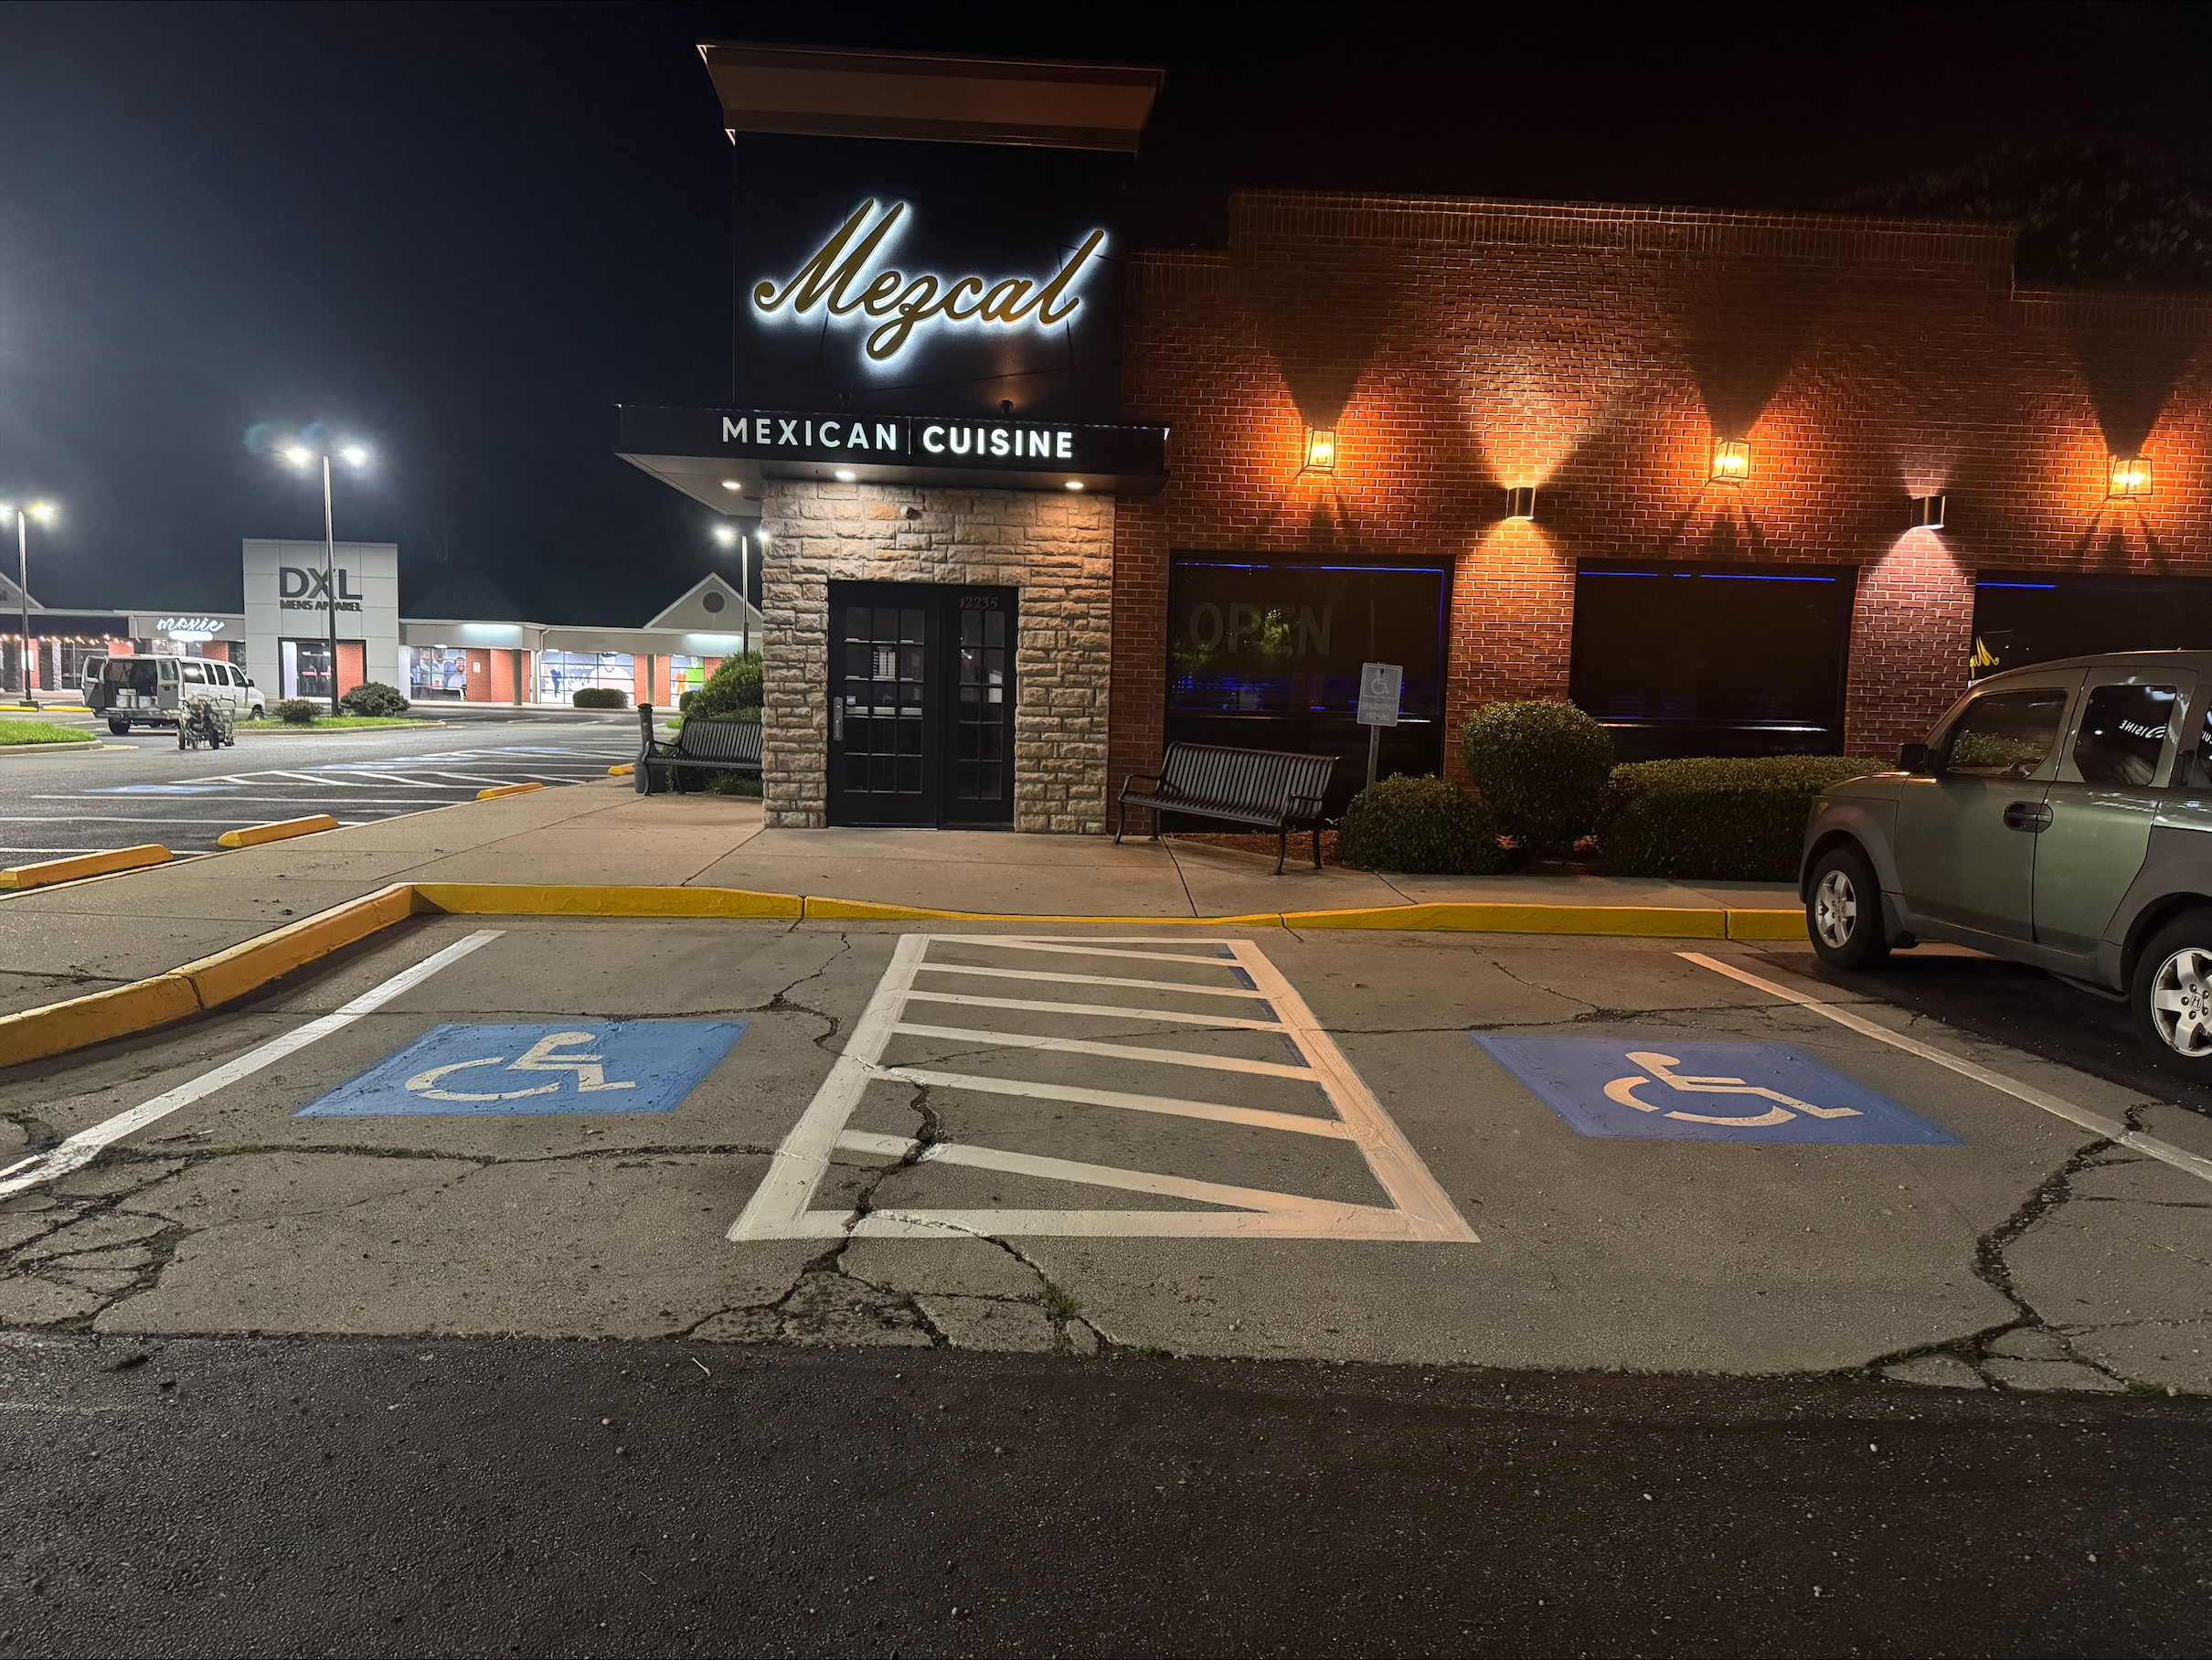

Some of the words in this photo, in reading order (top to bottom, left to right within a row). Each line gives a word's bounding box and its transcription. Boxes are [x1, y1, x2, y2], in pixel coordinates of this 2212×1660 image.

[753, 197, 1104, 361] Mezcal
[722, 416, 897, 451] MEXICAN
[922, 425, 1073, 458] CUISINE
[279, 567, 363, 600] DXL
[960, 595, 999, 610] 12235
[1188, 601, 1333, 656] OPEN
